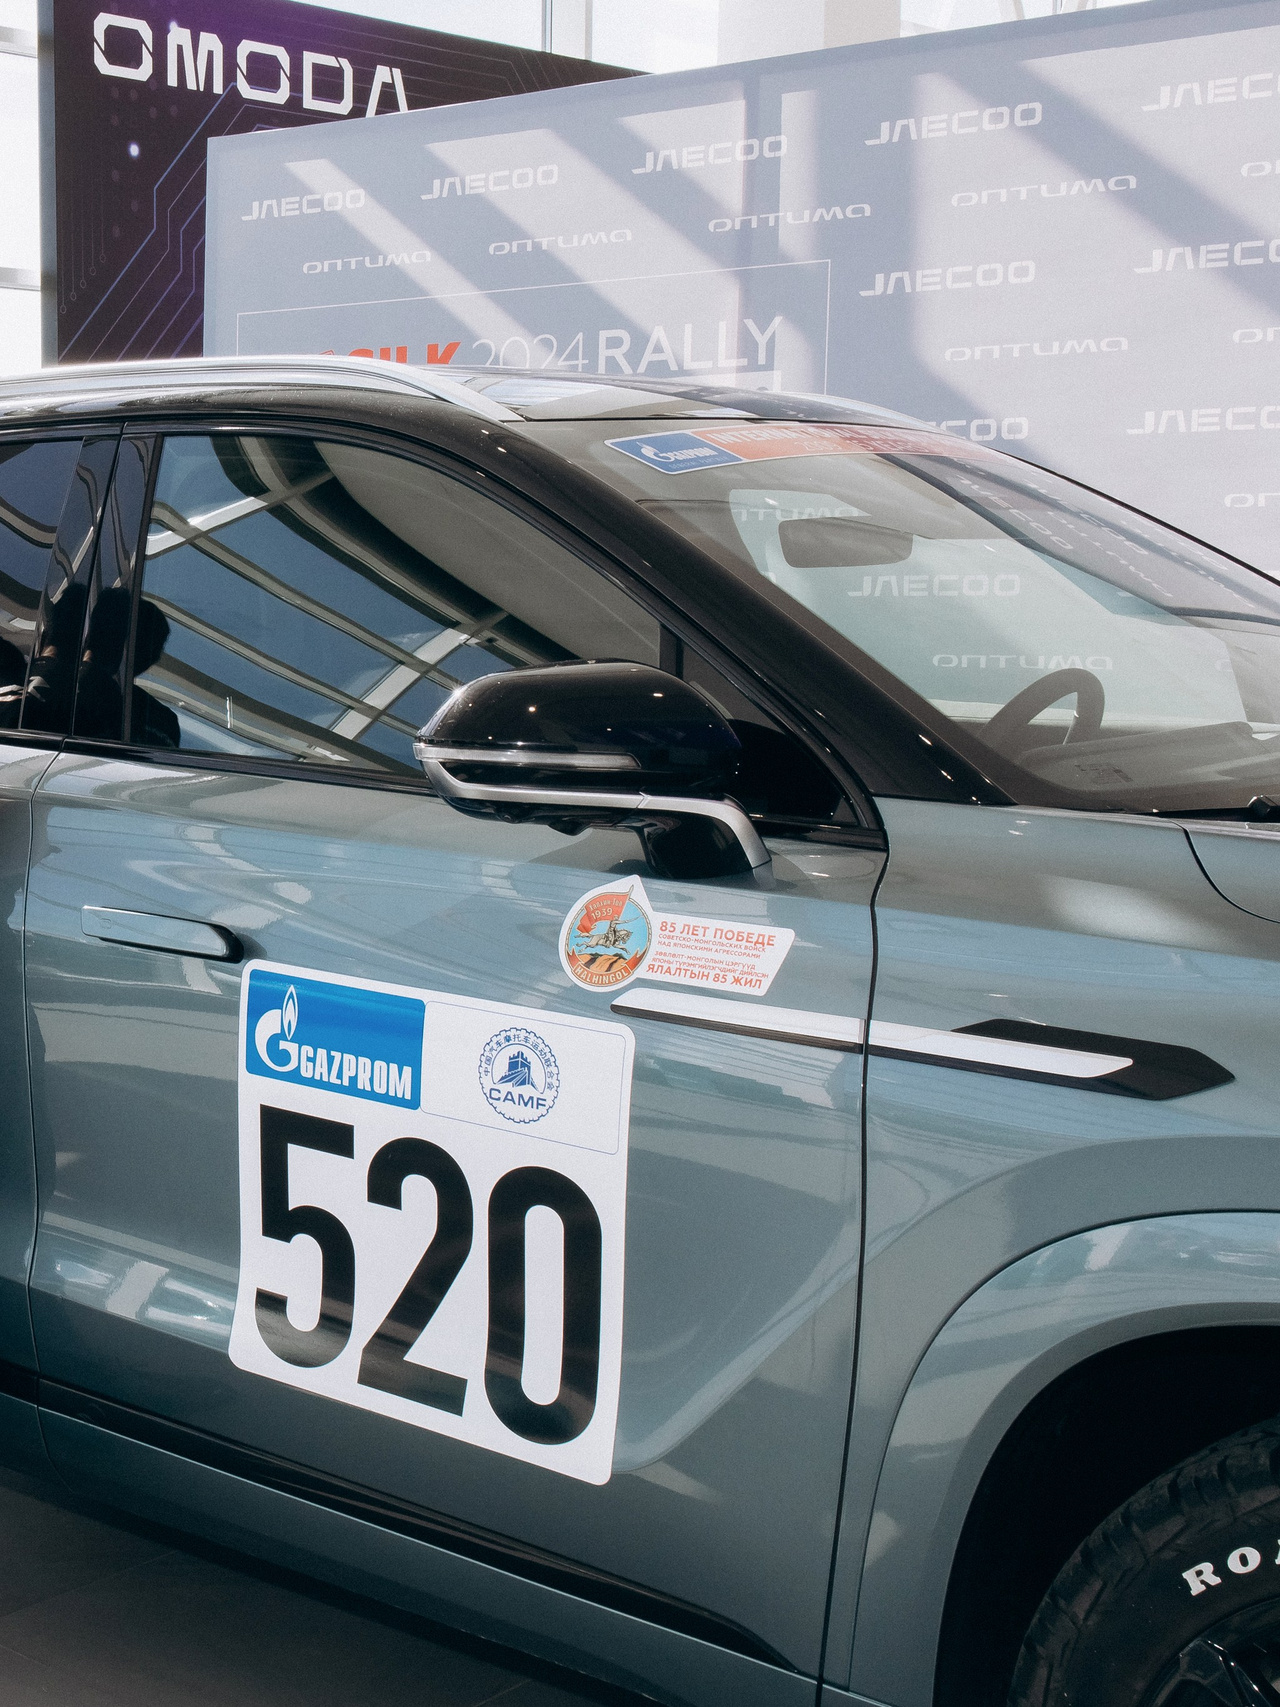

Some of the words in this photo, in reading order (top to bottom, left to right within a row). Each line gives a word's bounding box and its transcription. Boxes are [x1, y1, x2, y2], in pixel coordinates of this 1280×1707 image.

[94, 12, 408, 118] OMODA
[864, 102, 1042, 146] JAECOO
[631, 135, 788, 175] JAECOO
[420, 164, 558, 200] JAECOO
[241, 188, 366, 221] JAECOO
[859, 260, 1036, 297] JAECOO
[472, 332, 589, 371] 2024
[598, 316, 783, 375] RALLY
[847, 574, 1020, 597] JAECOO
[591, 907, 613, 920] 1939
[657, 940, 671, 948] НАД
[673, 942, 713, 953] ЯПОНСКИМИ
[714, 948, 761, 959] АГРЕССОРАМИ
[658, 933, 742, 950] СОВЕТСКО-МОНГОЛЬСКИХ
[744, 944, 766, 953] ВОЙСК
[660, 921, 676, 933] 85
[680, 923, 710, 937] ЛЕТ
[713, 928, 776, 947] ПОБЕДЕ
[575, 967, 629, 984] HALHINGOL
[646, 963, 710, 981] ЯЛАЛТЫН
[713, 973, 727, 984] 85
[731, 975, 762, 989] ЖИЛ
[300, 1042, 412, 1100] GAZPROM
[489, 1087, 547, 1110] CAMF
[255, 1103, 603, 1446] 520
